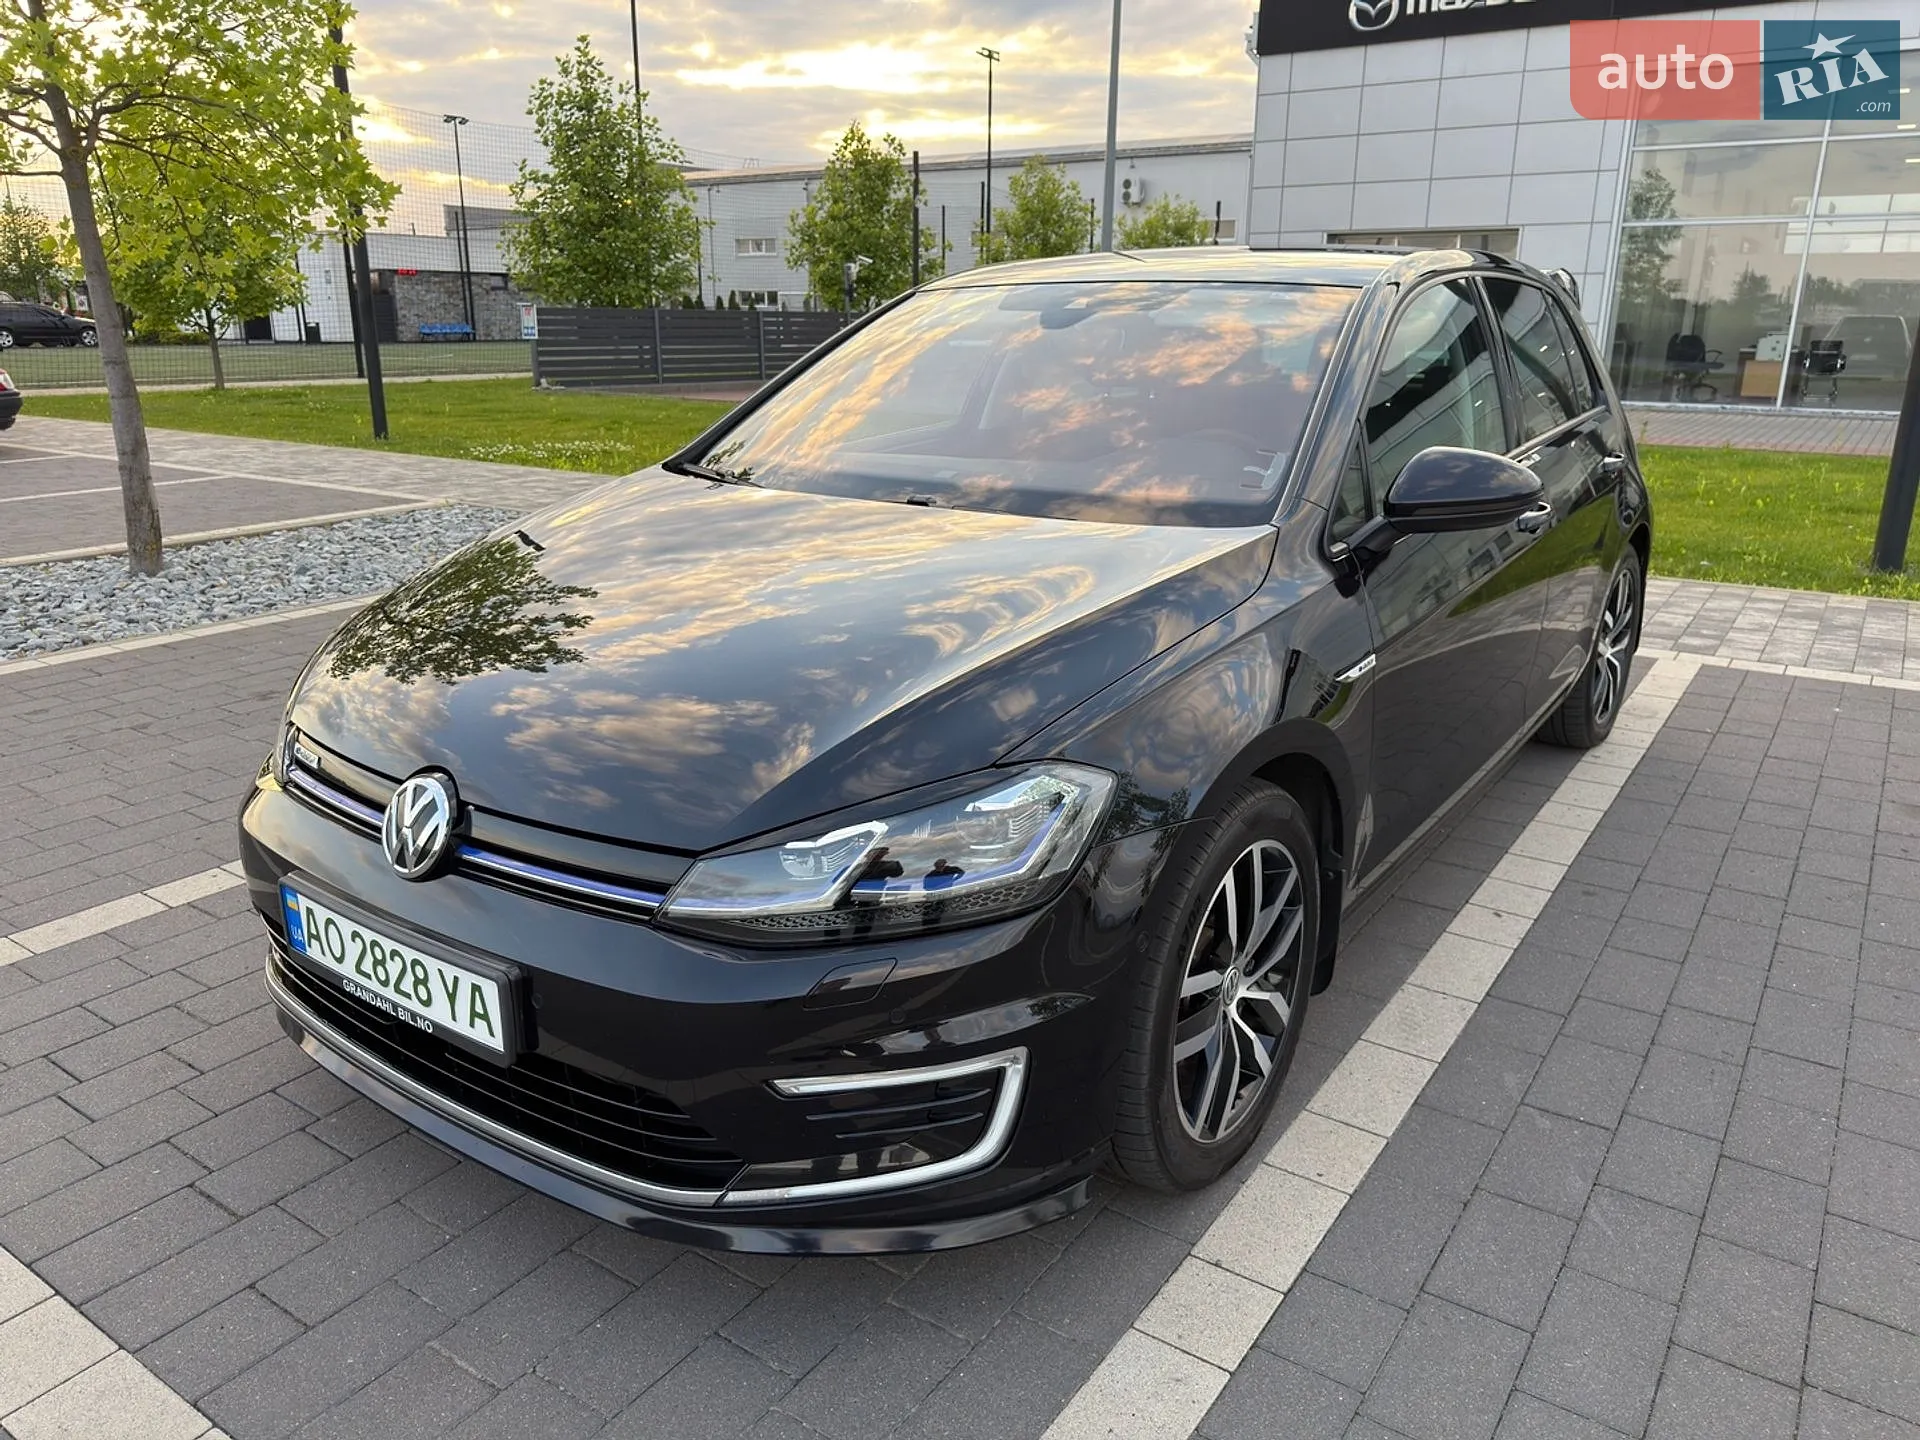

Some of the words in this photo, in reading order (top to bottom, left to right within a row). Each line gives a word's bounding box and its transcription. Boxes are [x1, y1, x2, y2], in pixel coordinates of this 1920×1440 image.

[305, 905, 346, 965] AO
[350, 929, 433, 1008] 2828
[437, 967, 496, 1039] YA
[342, 979, 397, 1017] GRANDAHL
[398, 1007, 433, 1034] BIL.NO
